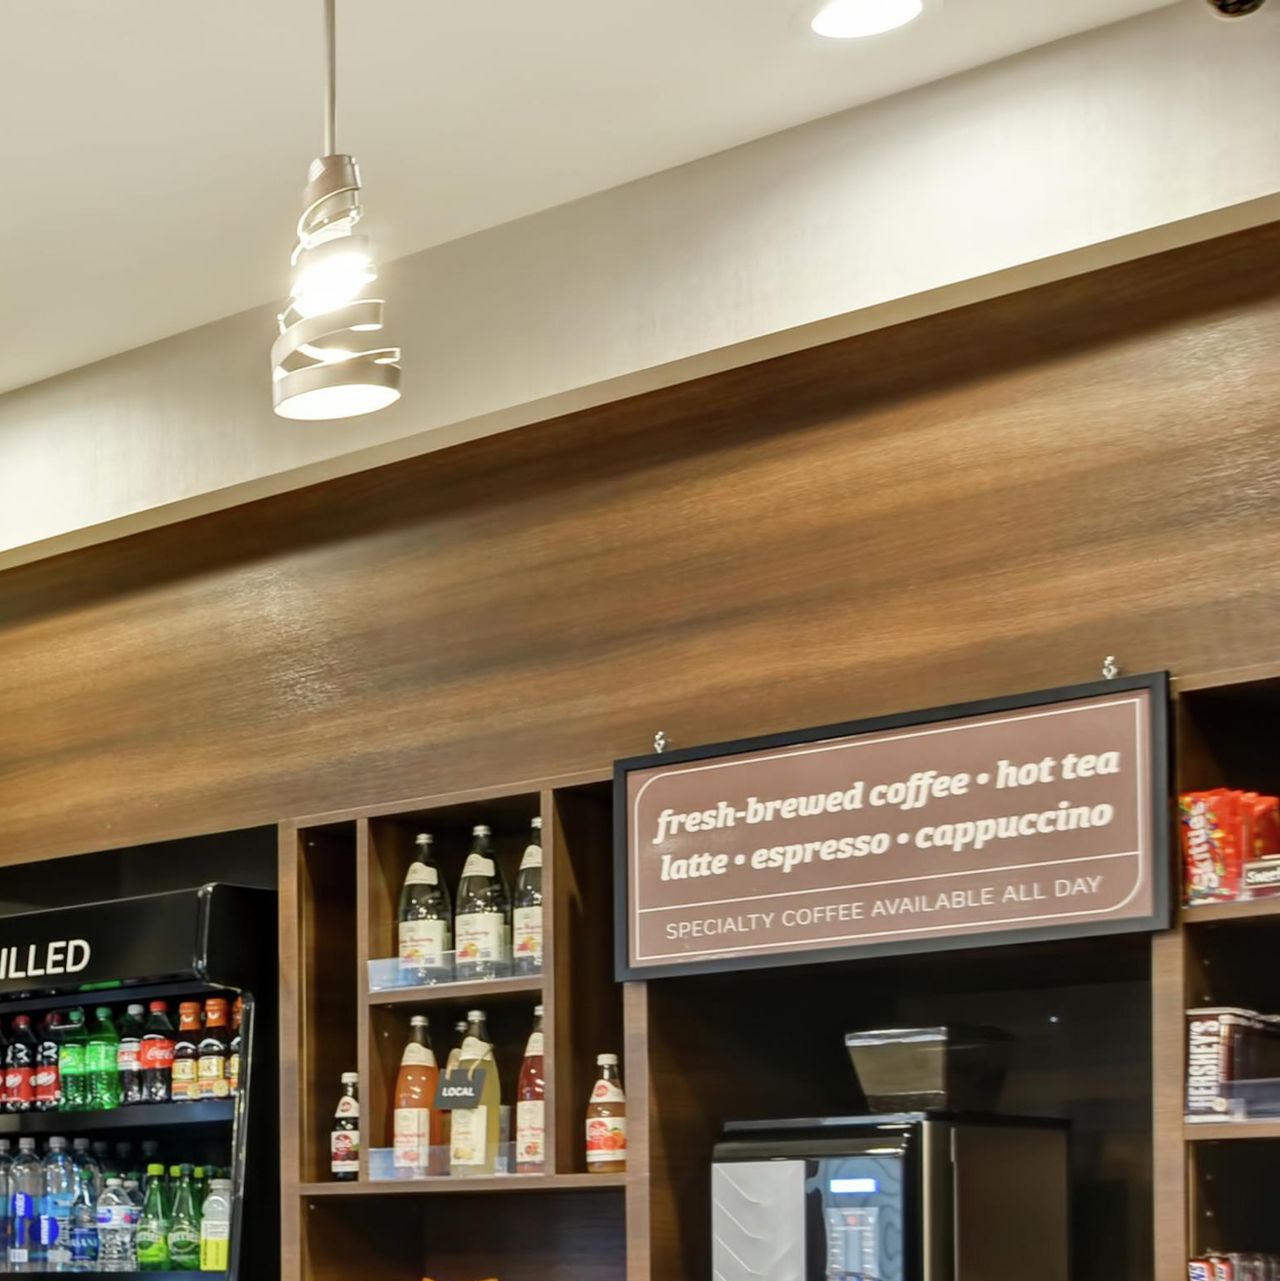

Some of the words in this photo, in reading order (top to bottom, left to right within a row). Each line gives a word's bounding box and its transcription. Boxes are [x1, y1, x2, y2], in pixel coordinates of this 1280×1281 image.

[652, 781, 865, 845] fresh-brewed
[868, 771, 970, 812] coffee
[995, 758, 1057, 791] hot
[1061, 748, 1120, 781] tea
[659, 846, 728, 882] latte
[750, 830, 891, 874] espresso
[914, 801, 1115, 855] cappuccino
[664, 911, 776, 942] SPECIALTY
[781, 902, 865, 929] COFFEE
[870, 886, 996, 919] AVAILABLE
[1001, 880, 1047, 905] ALL
[1054, 874, 1104, 899] DAY
[441, 1086, 476, 1098] LOCAL
[1187, 1018, 1220, 1113] HERSHEY'S
